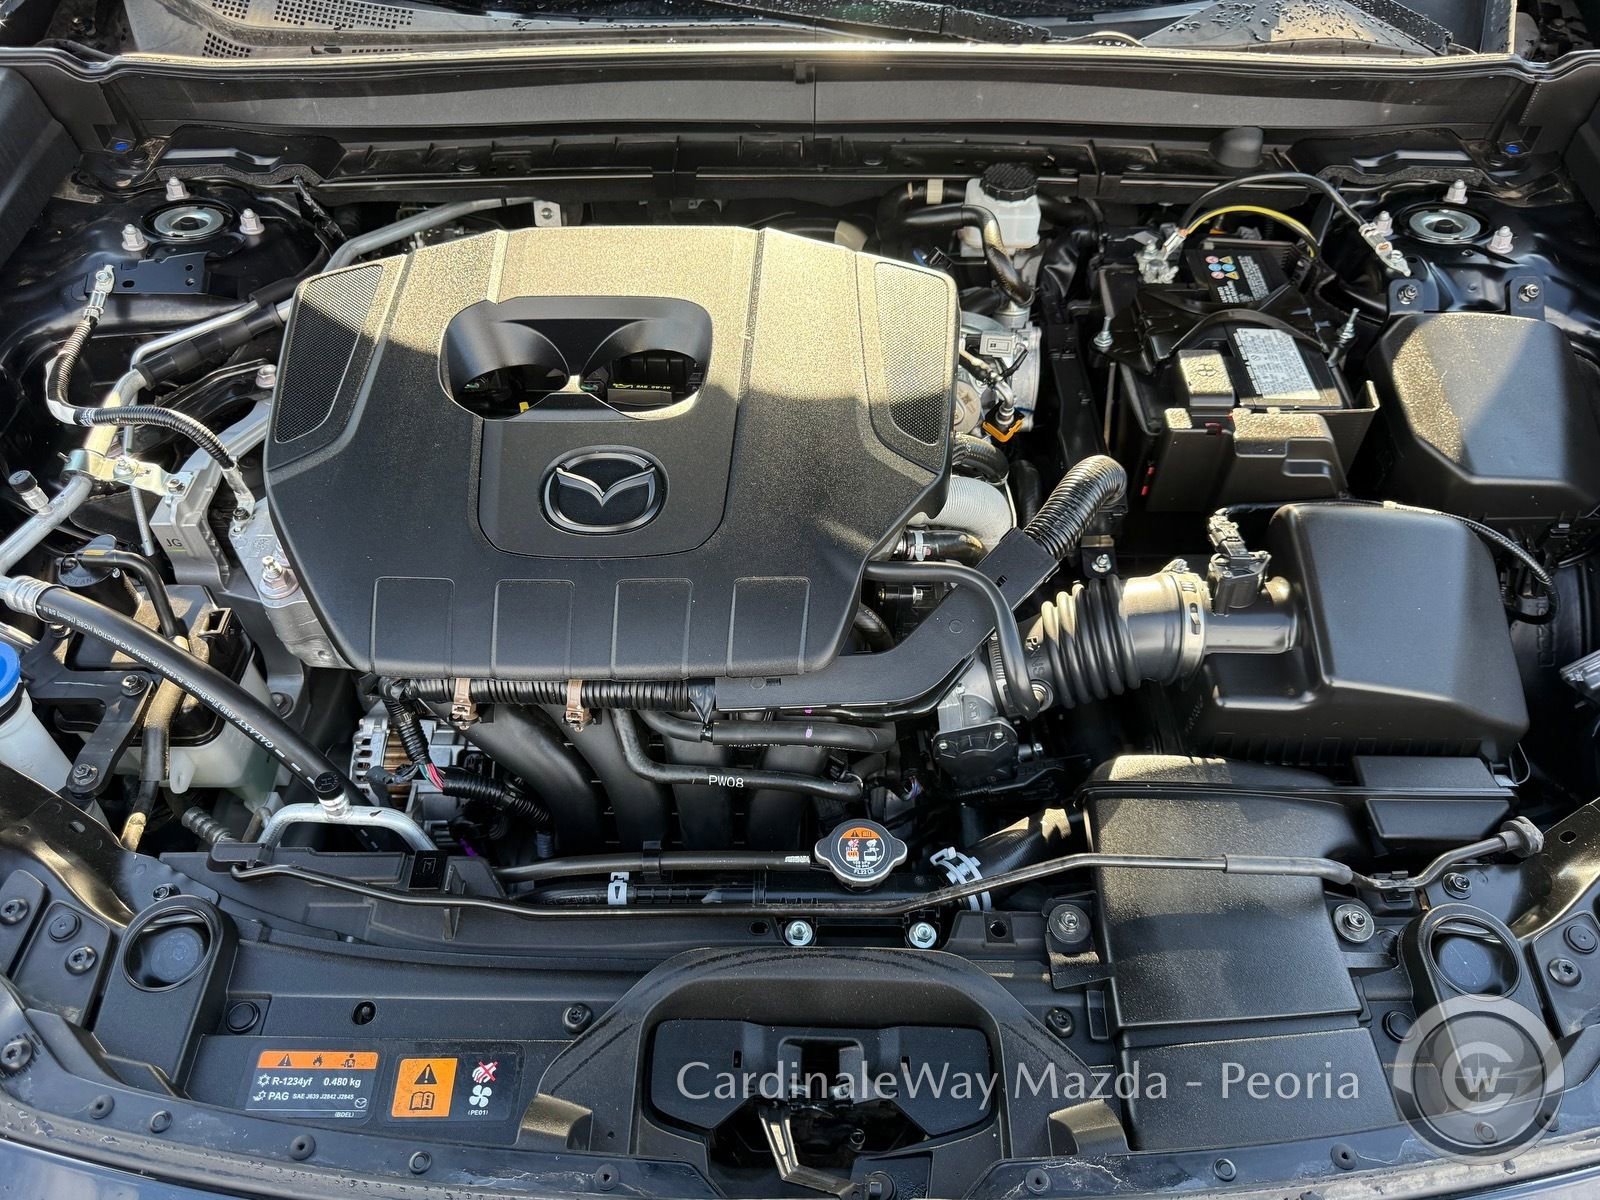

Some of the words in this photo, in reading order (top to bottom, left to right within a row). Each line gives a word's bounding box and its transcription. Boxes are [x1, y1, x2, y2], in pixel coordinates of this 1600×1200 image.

[76, 620, 94, 632] HOSE
[94, 627, 121, 647] SUCTION
[185, 682, 220, 709] FlexBarrier
[236, 719, 274, 748] GALAXY
[708, 774, 744, 788] PW08
[272, 1077, 313, 1088] R-1234yf
[323, 1077, 348, 1086] 0.480
[350, 1077, 361, 1088] kg
[268, 1092, 289, 1101] PAG
